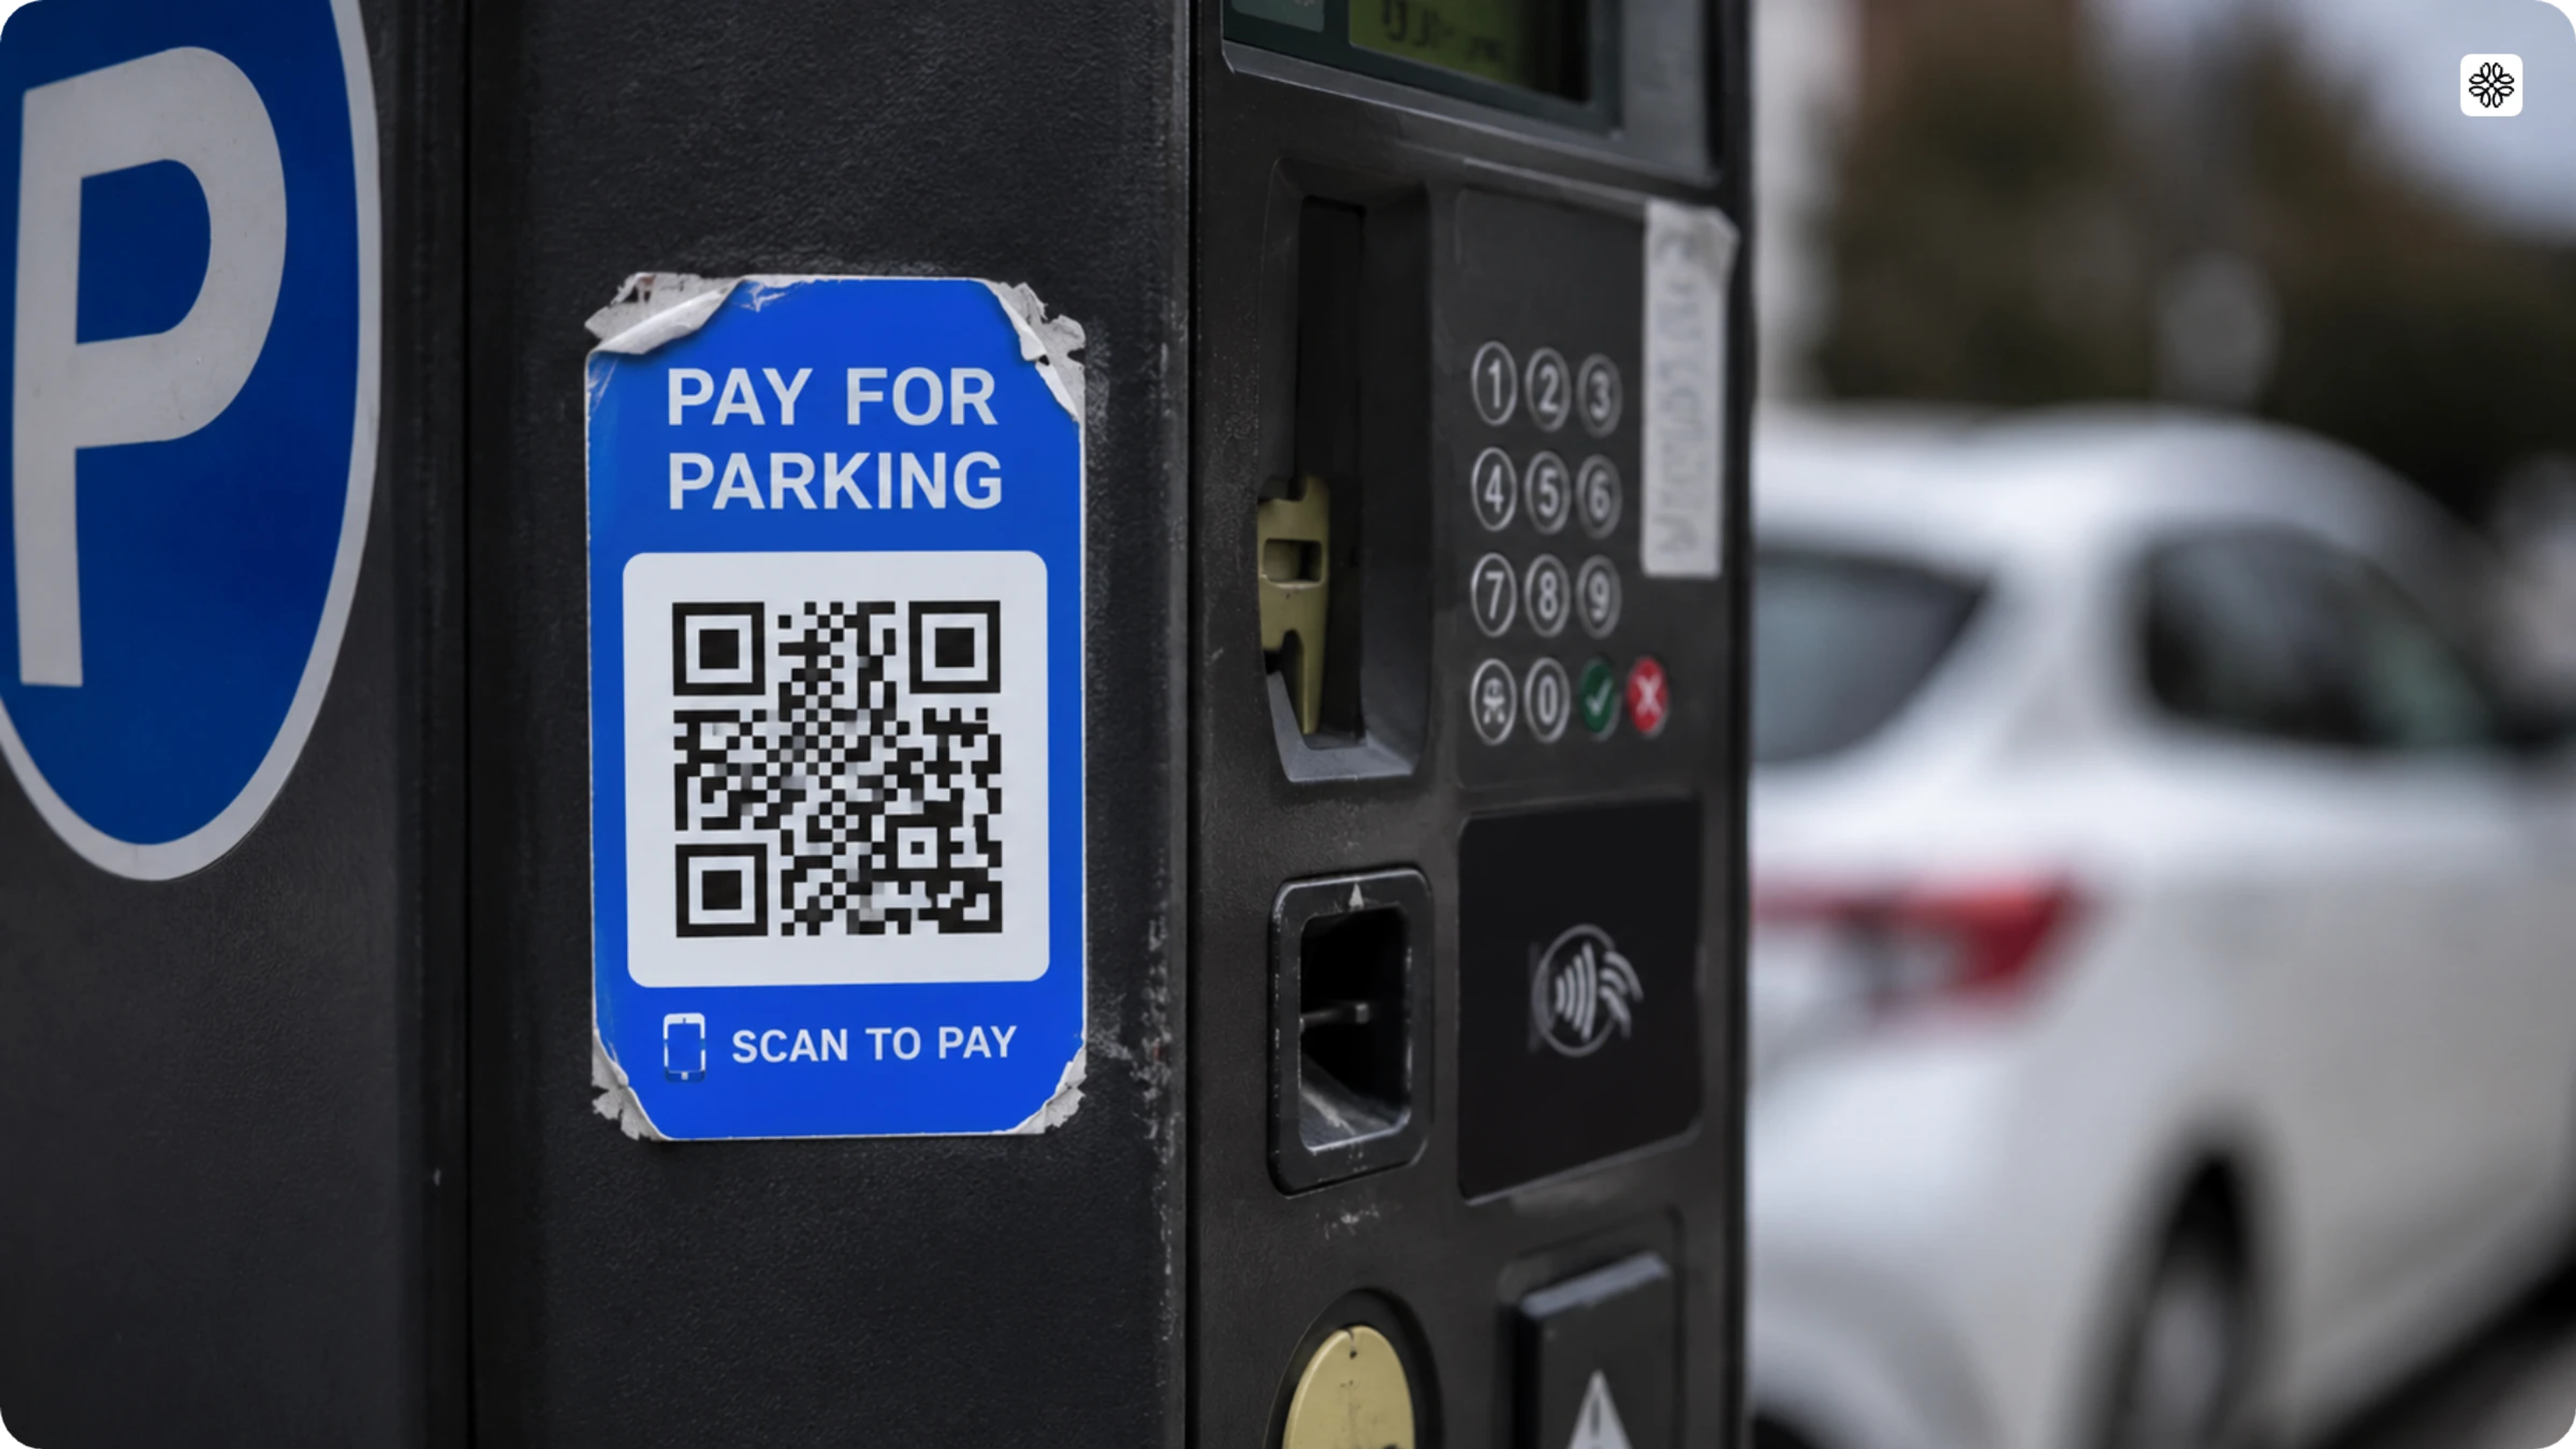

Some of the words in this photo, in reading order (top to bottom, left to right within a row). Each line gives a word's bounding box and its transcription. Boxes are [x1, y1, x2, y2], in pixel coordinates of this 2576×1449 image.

[13, 46, 287, 688] P
[1488, 358, 1501, 409] 1
[1539, 364, 1559, 412] 2
[1591, 370, 1611, 420] 3
[667, 367, 813, 426] PAY
[847, 367, 999, 426] FOR
[669, 451, 1002, 510] PARKING
[1485, 464, 1504, 513] 4
[1539, 467, 1559, 517] 5
[1590, 470, 1610, 520] 6
[1485, 571, 1505, 619] 7
[1538, 570, 1558, 620] 8
[1589, 572, 1610, 621] 9
[1537, 675, 1558, 725] 0
[732, 1028, 848, 1064] SCAN
[865, 1026, 921, 1061] TO
[938, 1024, 1018, 1059] PAY
